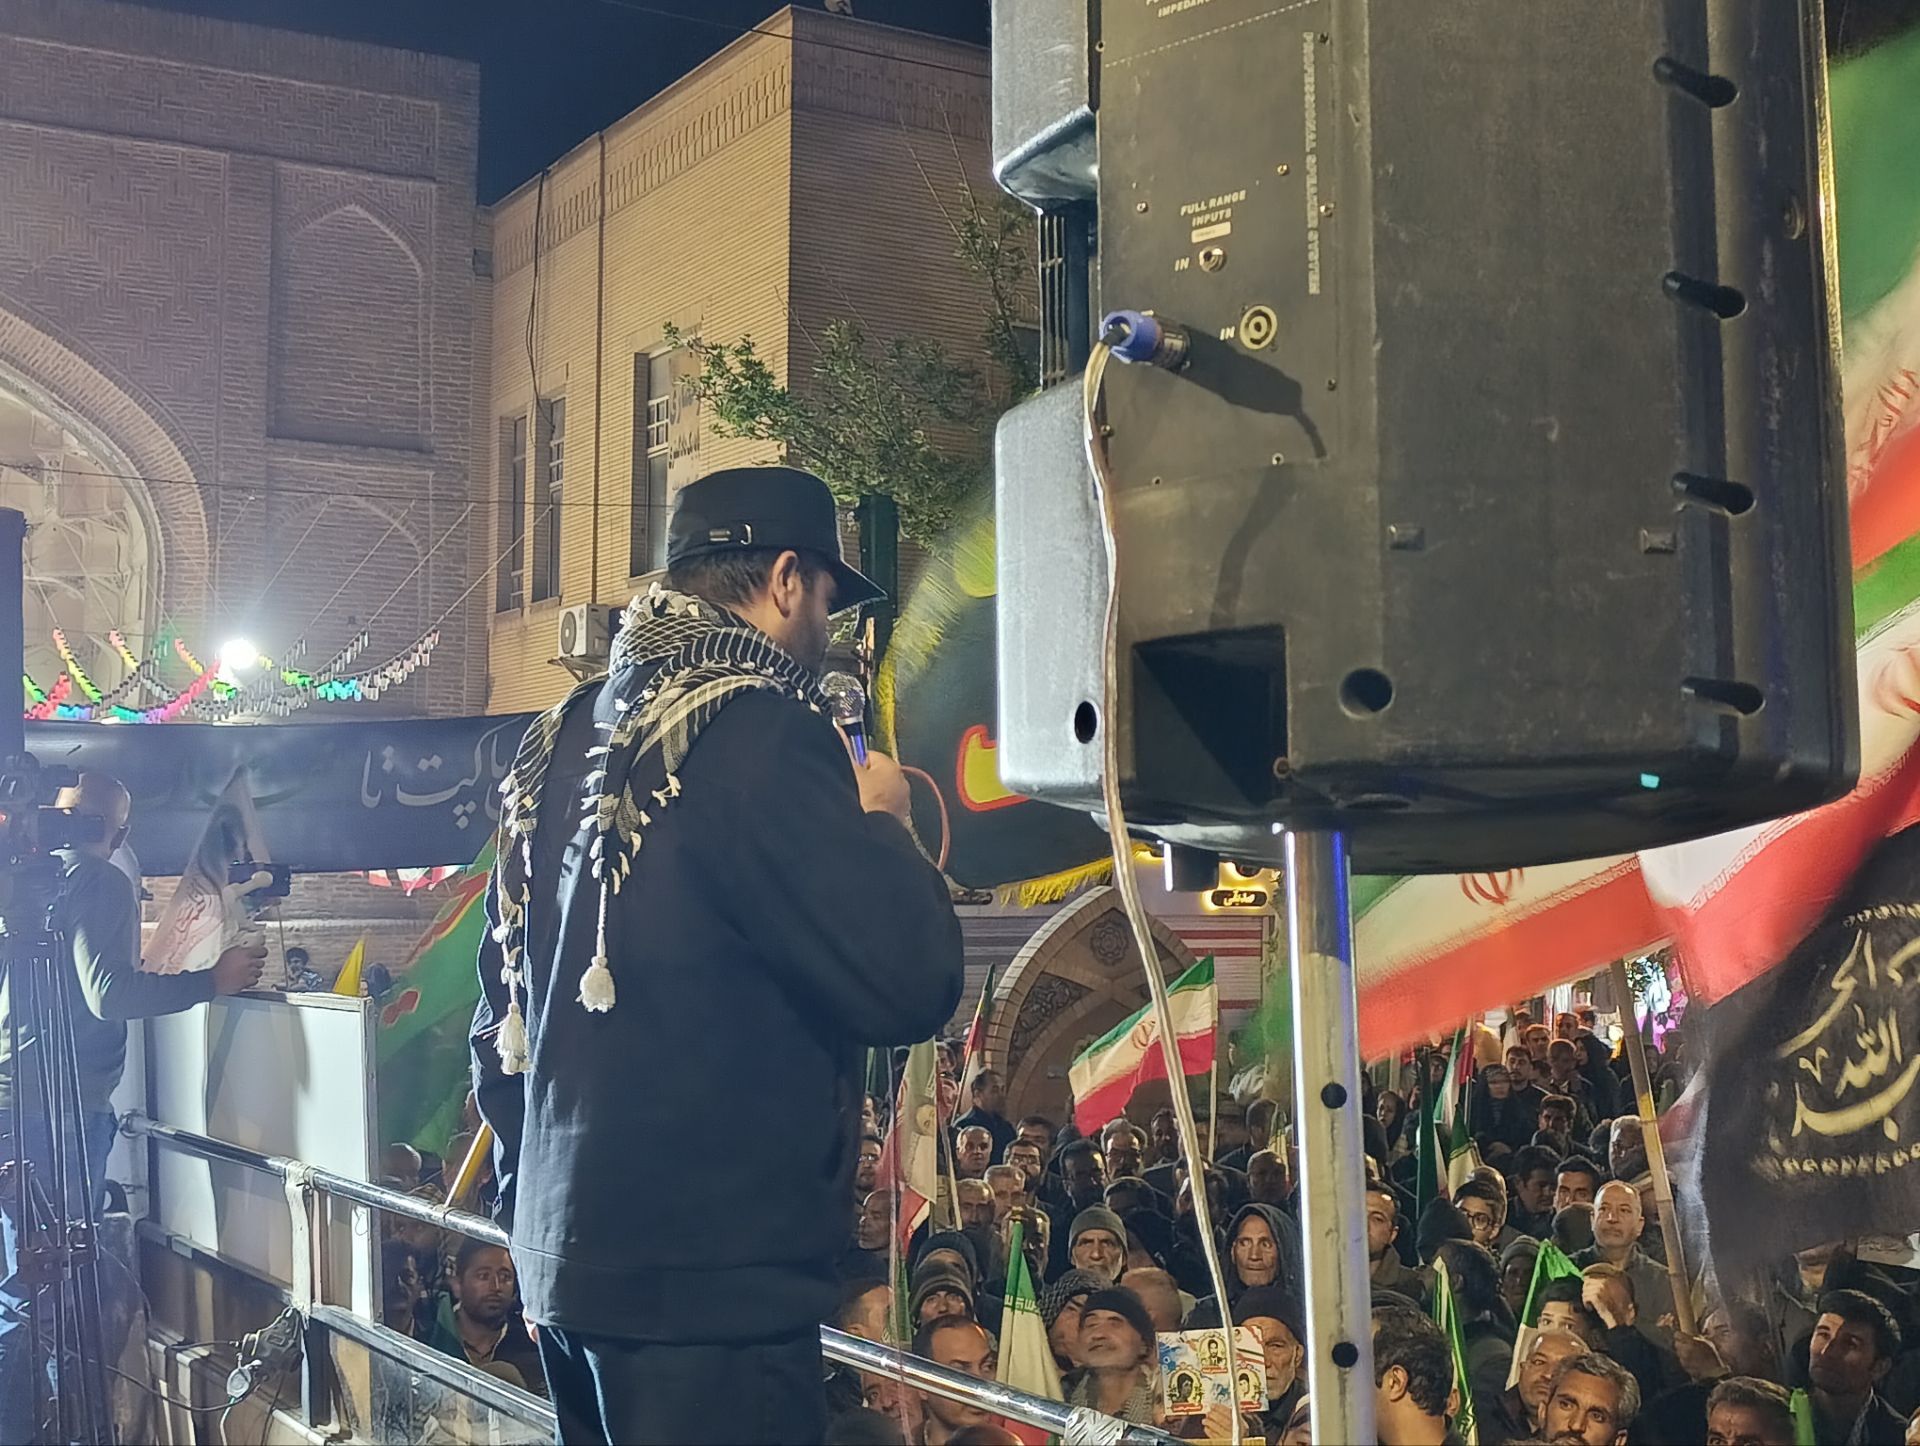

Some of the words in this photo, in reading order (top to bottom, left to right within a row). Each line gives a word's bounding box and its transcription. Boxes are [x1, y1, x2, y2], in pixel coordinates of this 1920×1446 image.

[1158, 0, 1210, 17] IMPEDAN
[1181, 201, 1208, 216] FULL
[1209, 190, 1246, 209] RANGE
[1192, 208, 1232, 227] INPUTS
[1174, 257, 1190, 271] IN
[1220, 326, 1235, 341] IN
